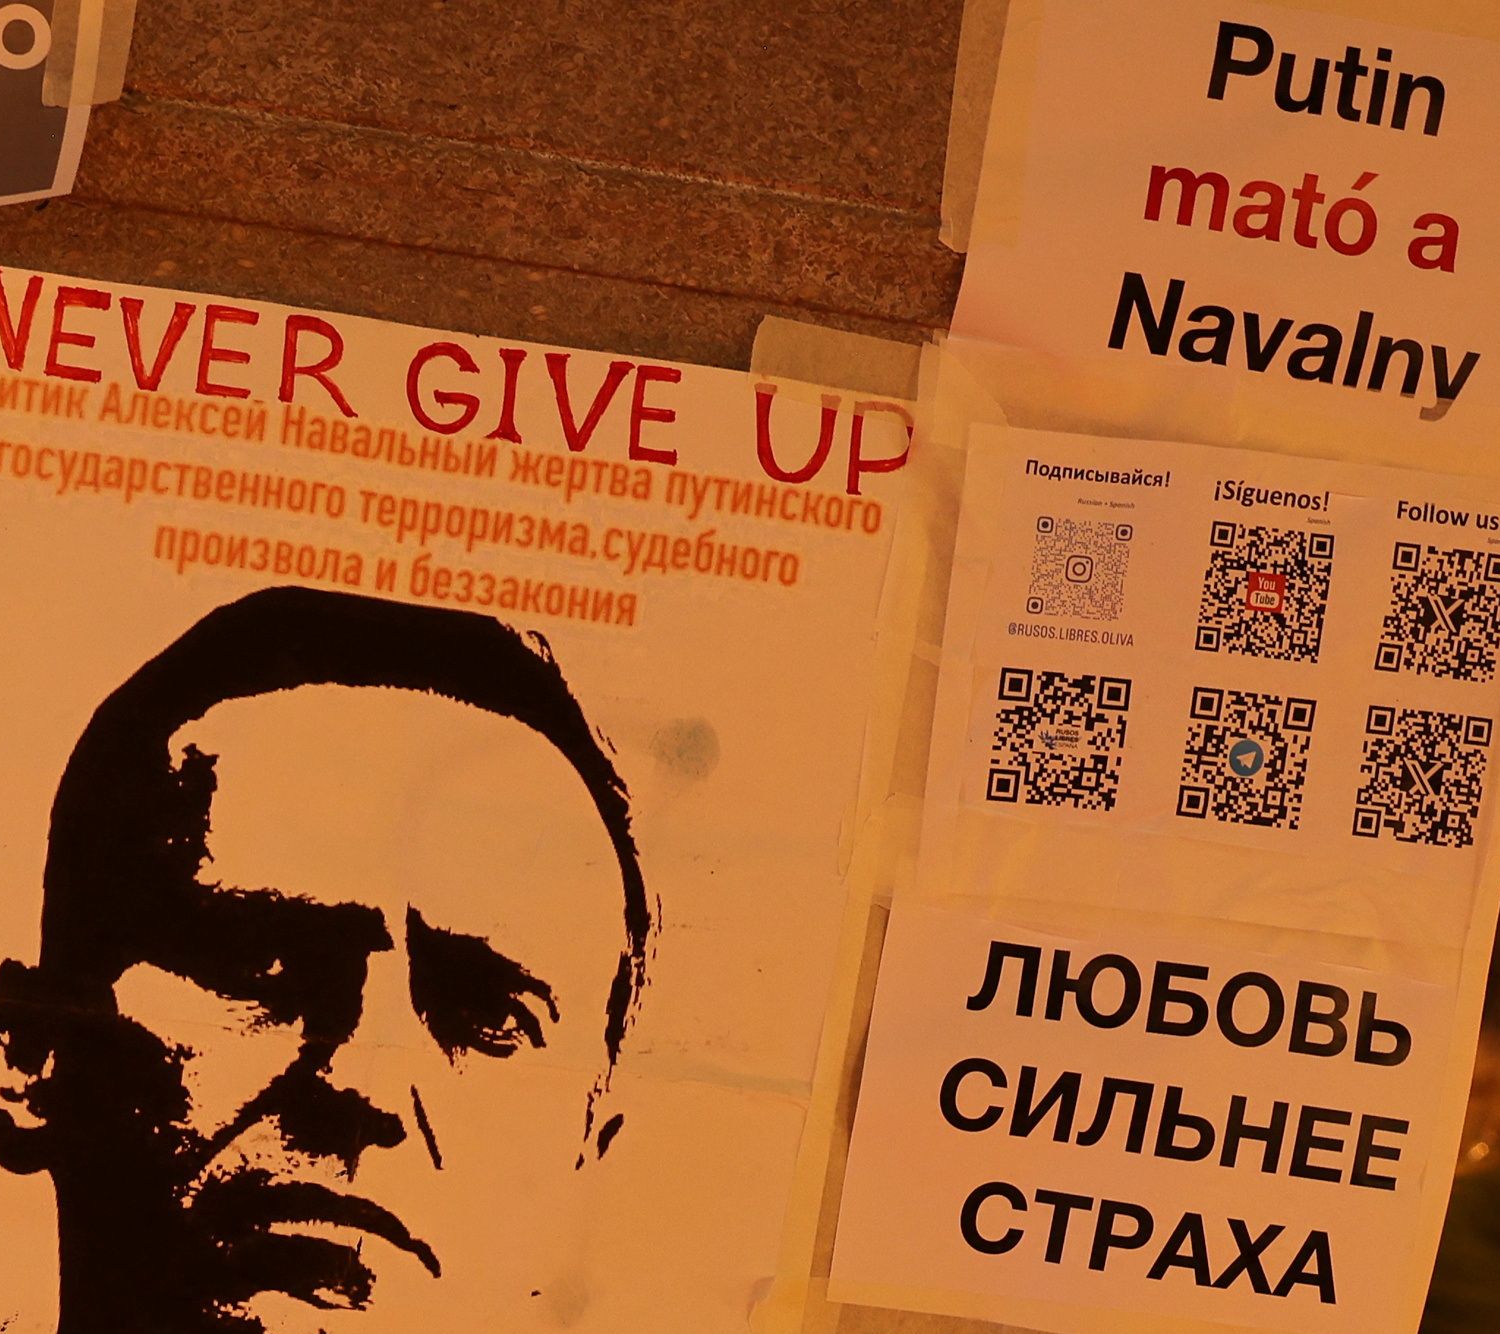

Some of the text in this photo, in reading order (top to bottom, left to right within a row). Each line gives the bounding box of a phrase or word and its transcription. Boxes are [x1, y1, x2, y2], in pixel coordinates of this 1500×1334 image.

[1206, 20, 1446, 138] Putin
[1143, 165, 1460, 273] mató a
[1107, 271, 1481, 422] Navalny
[99, 381, 268, 443] Алексей
[280, 405, 498, 480] Навальный
[509, 452, 654, 505] жертва
[665, 470, 883, 536] путинского
[406, 341, 682, 467] GIVE
[753, 382, 915, 496] UP
[1025, 459, 1171, 488] Подписывайся!
[1213, 478, 1331, 514] ¡Síguenos!
[1396, 500, 1470, 528] Follow
[154, 523, 639, 628] произвола и беззакония
[1254, 592, 1276, 607] Tube
[1257, 575, 1277, 591] You
[1008, 622, 1135, 648] @RUSOS.LIBRES.OLIVA
[966, 940, 1413, 1068] ЛЮБОВЬ
[938, 1057, 1411, 1191] СИЛЬНЕЕ
[960, 1181, 1338, 1305] СТРАХА
